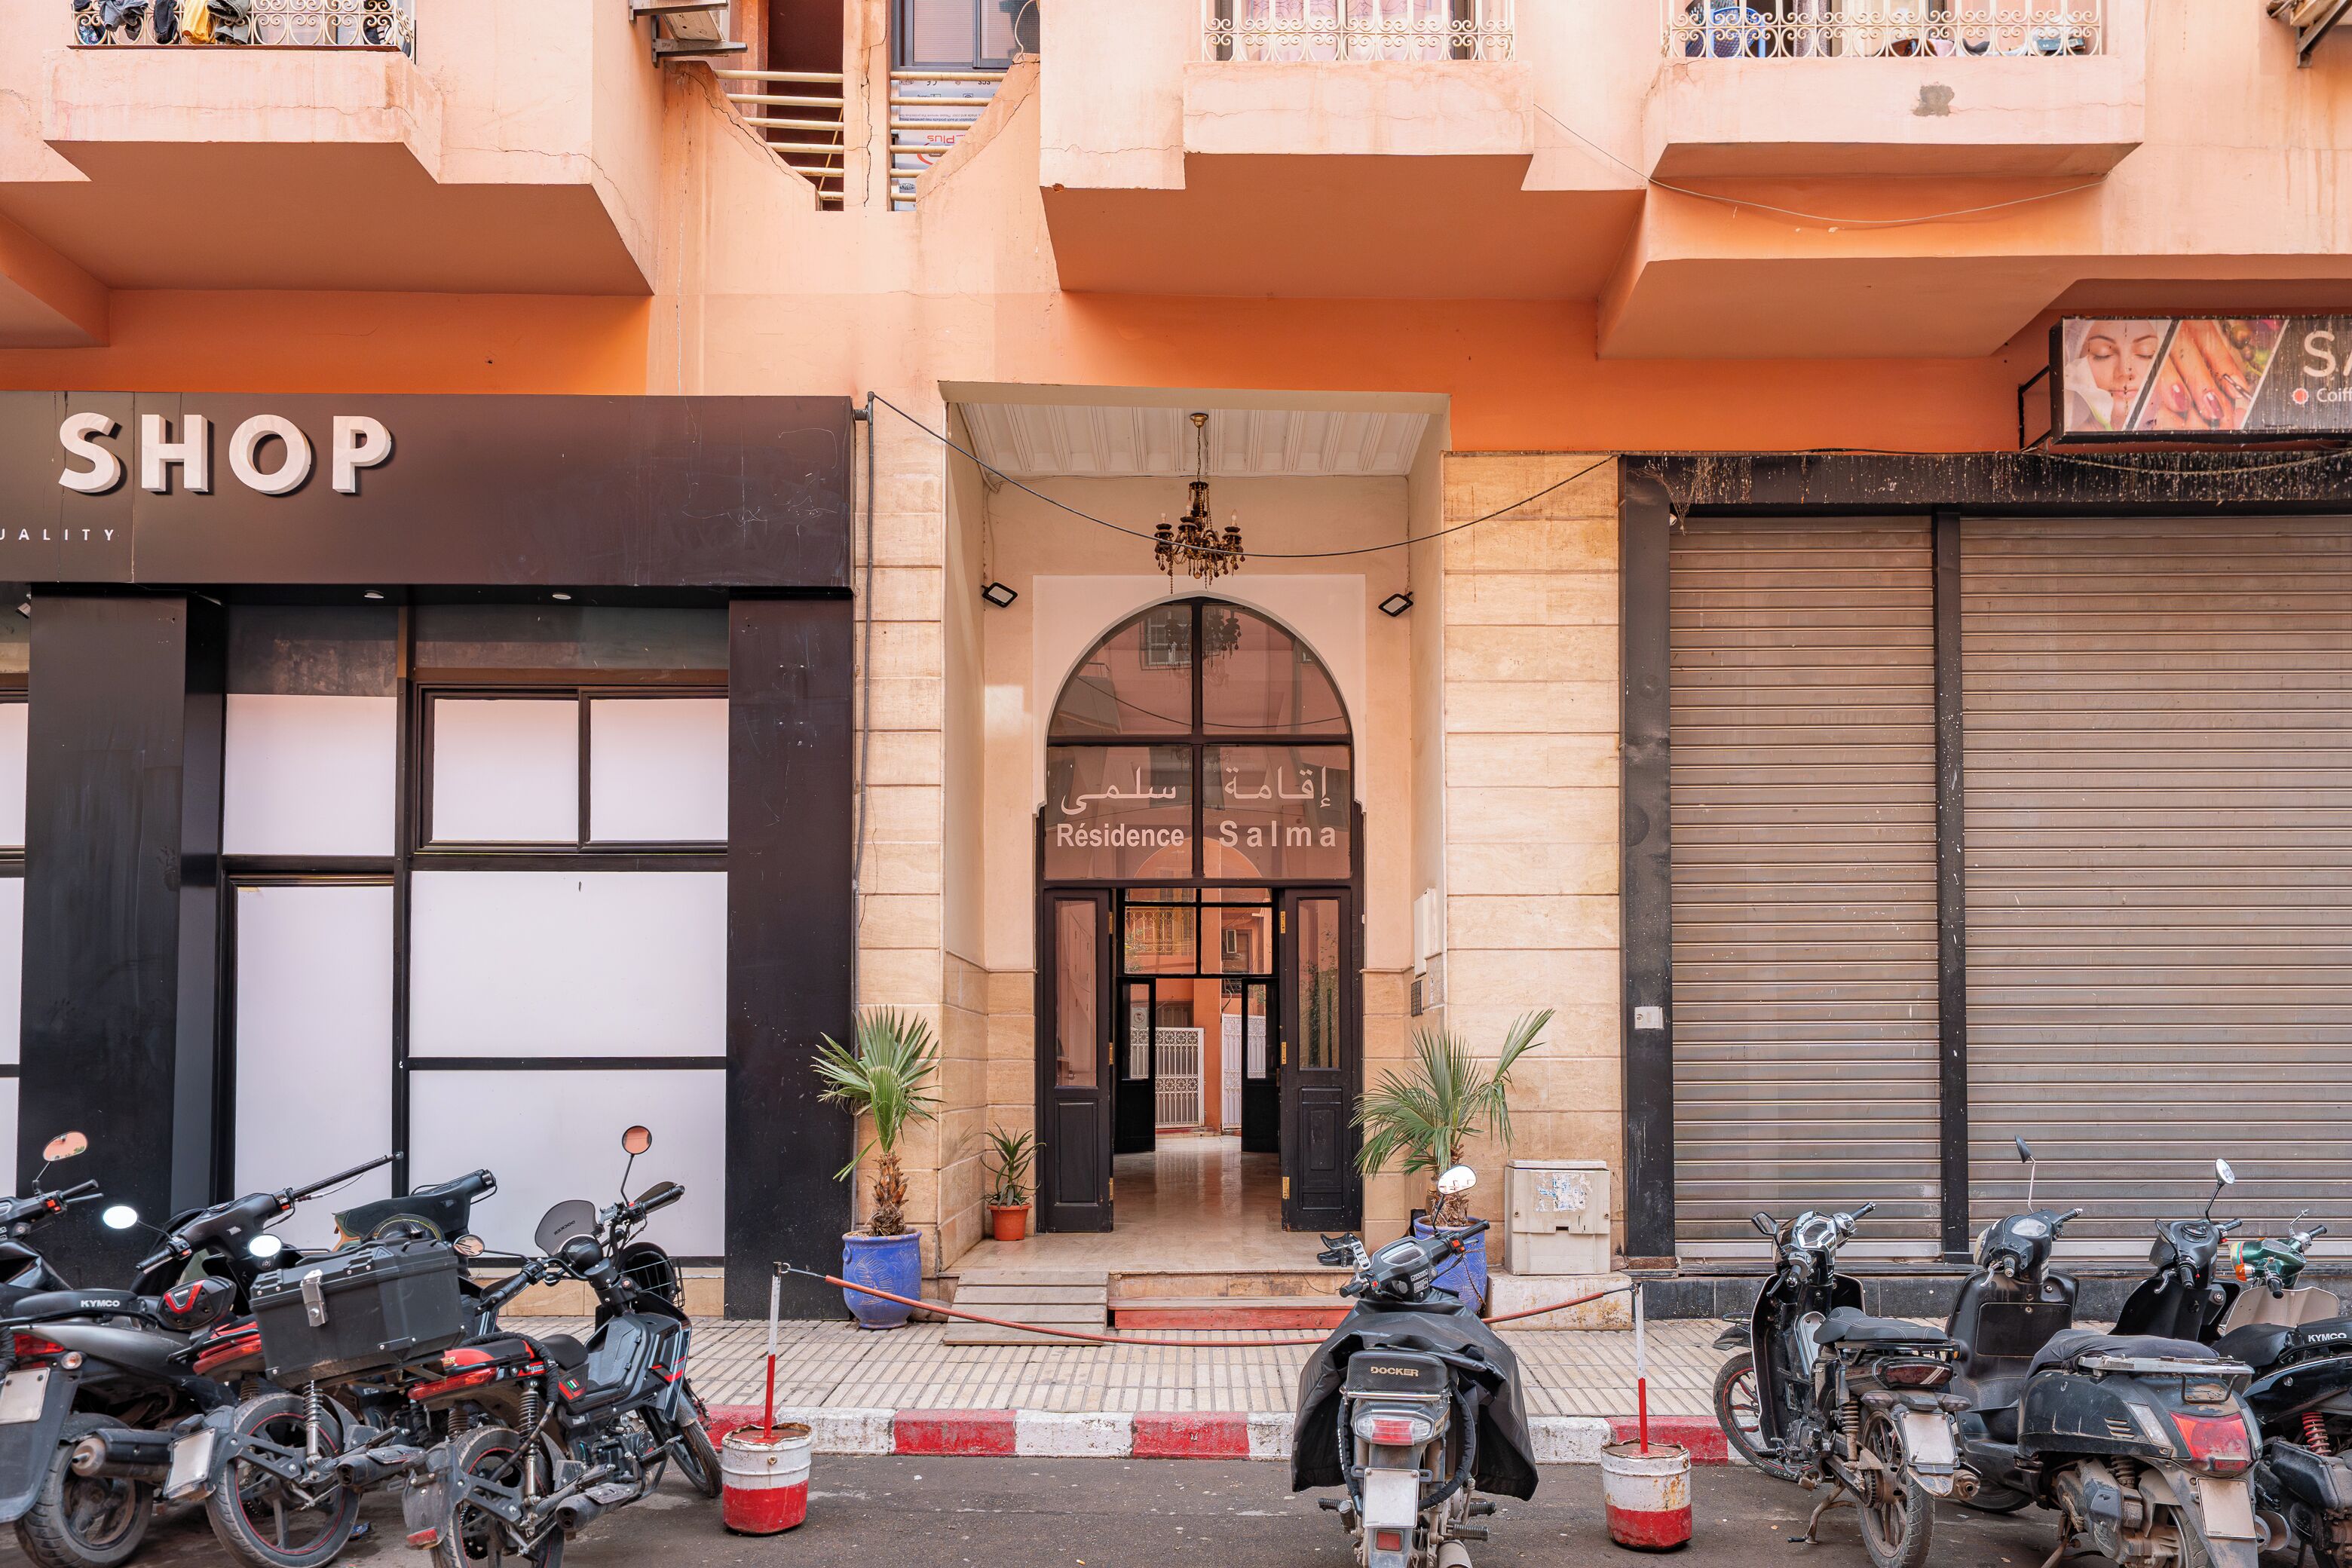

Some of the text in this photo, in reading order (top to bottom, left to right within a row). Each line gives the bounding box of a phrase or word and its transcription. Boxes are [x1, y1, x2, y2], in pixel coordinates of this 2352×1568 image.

[926, 135, 955, 144] Plus
[58, 412, 392, 495] SHOP
[1061, 765, 1331, 815] إقامة سلمى
[1056, 819, 1337, 848] Résidence Salma
[80, 1300, 121, 1308] KYMCO
[2308, 1332, 2347, 1343] KYMCO
[1370, 1366, 1419, 1377] DOCKER
